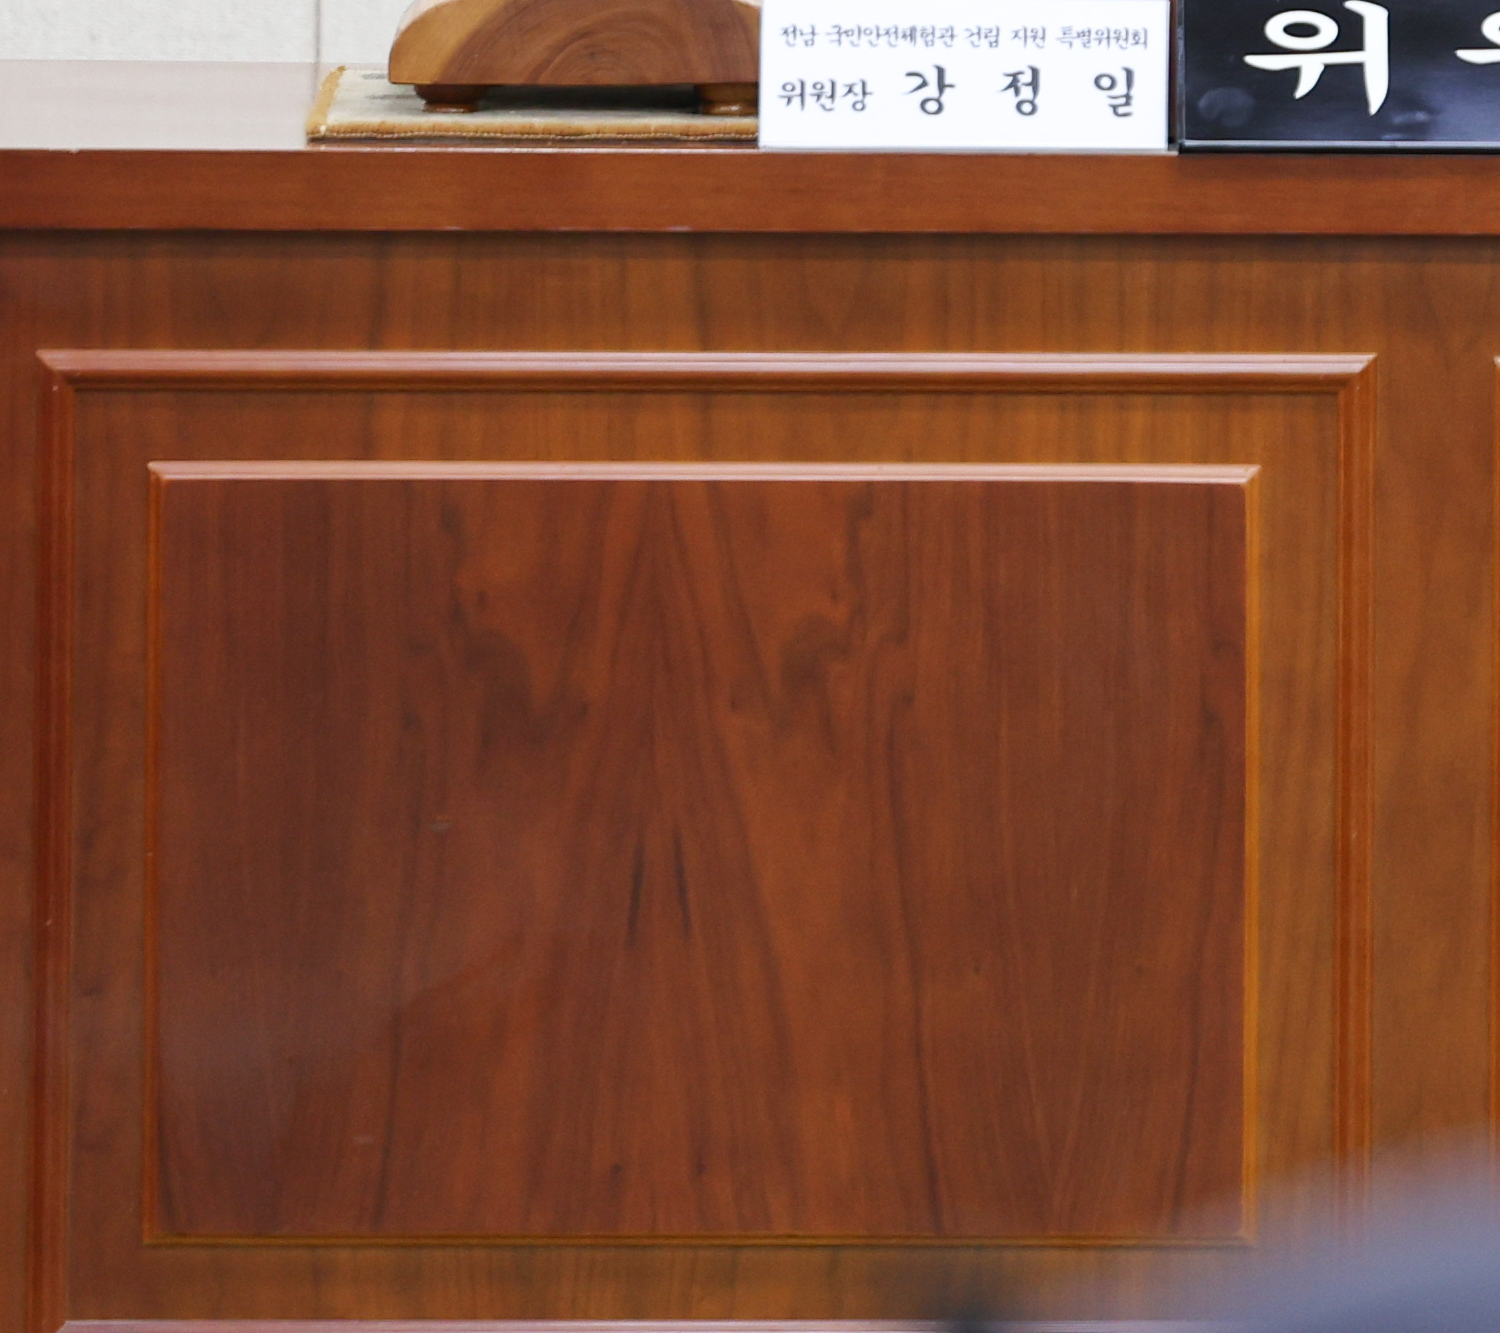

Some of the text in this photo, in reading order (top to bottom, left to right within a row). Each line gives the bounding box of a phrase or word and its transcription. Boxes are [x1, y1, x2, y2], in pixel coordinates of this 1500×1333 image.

[781, 23, 1149, 50] 전남 국민안전체험관 건립 지원 특별위원회
[777, 77, 874, 113] 위원장
